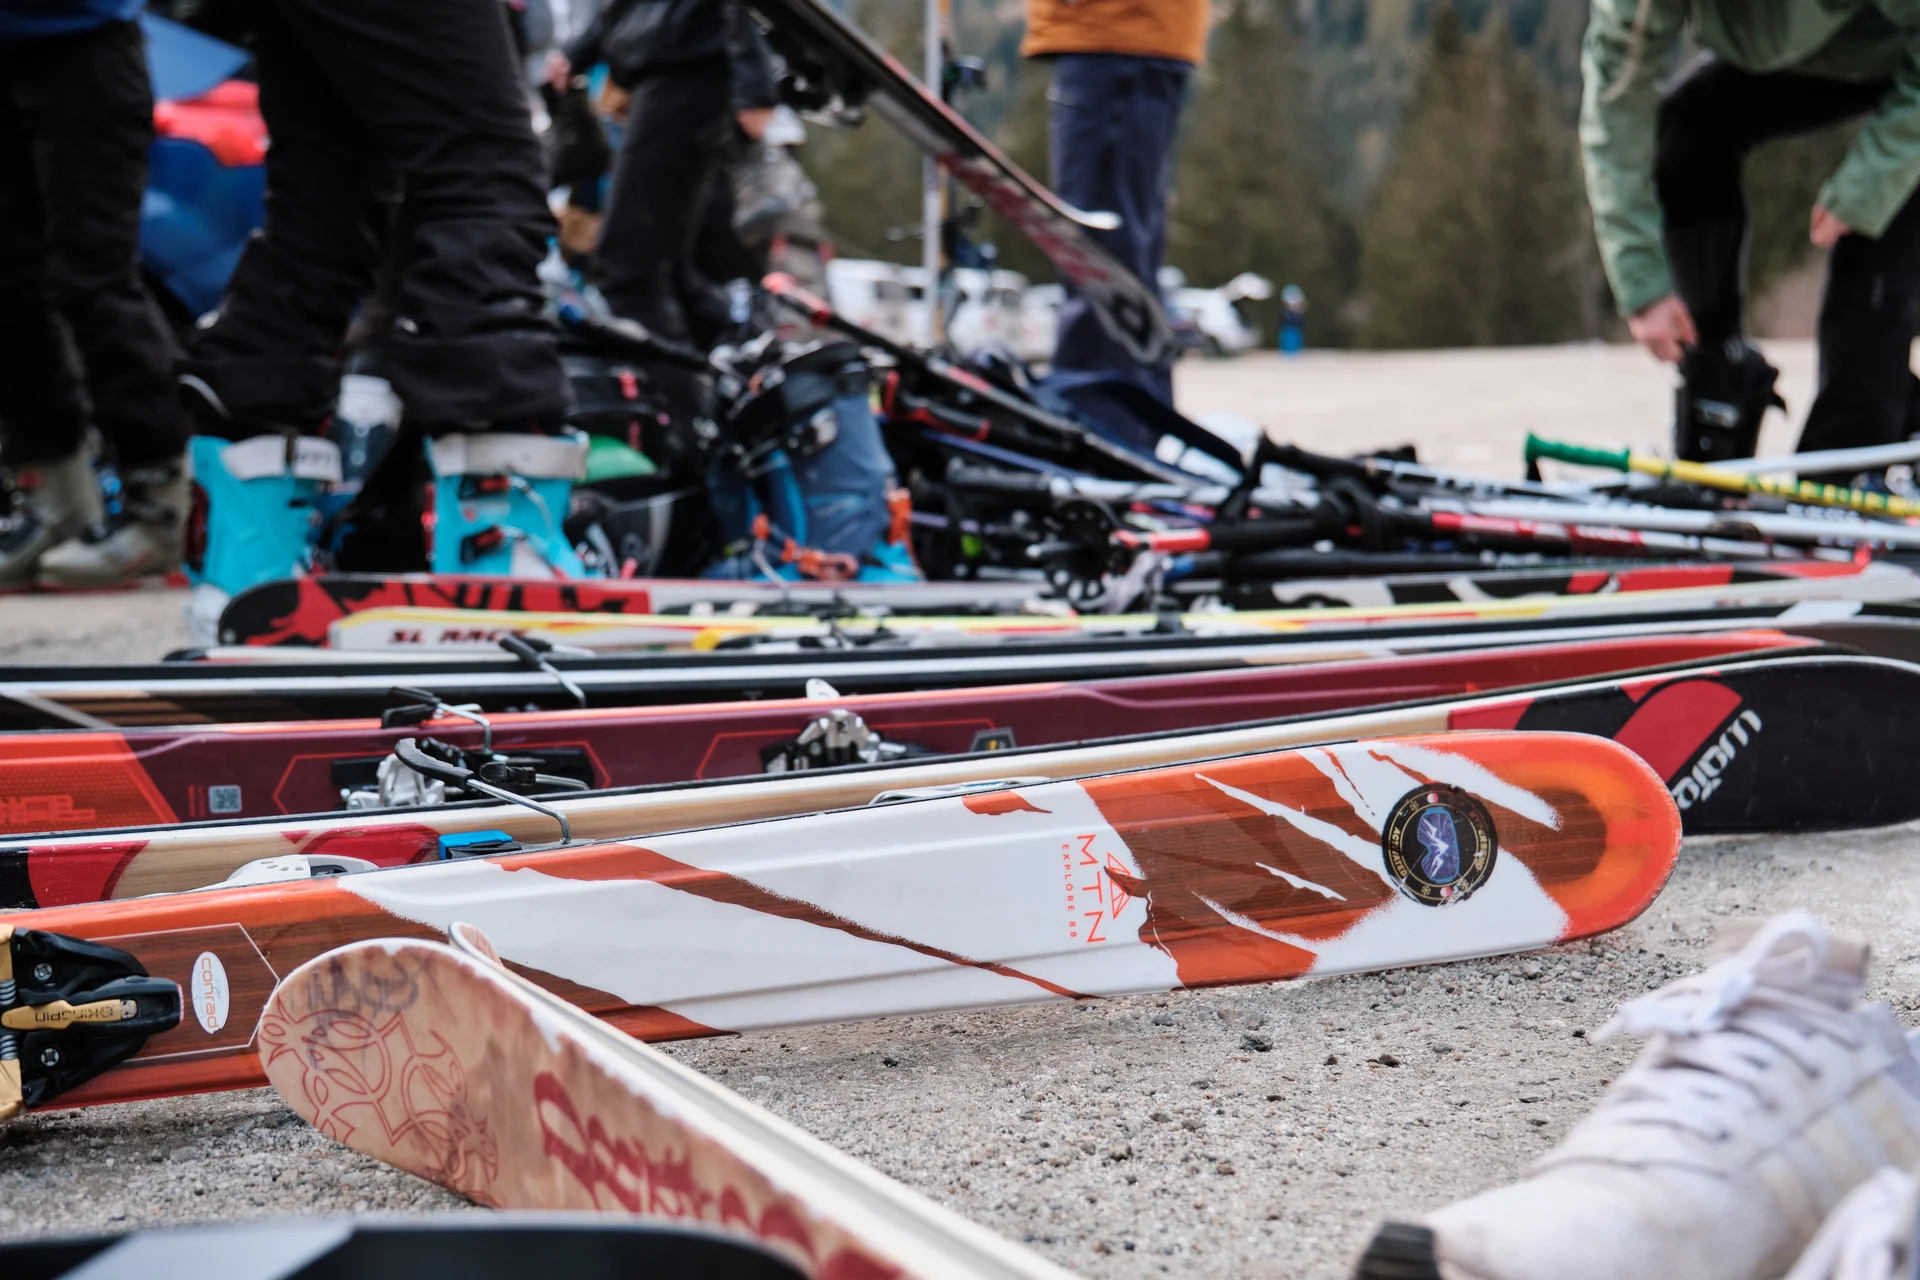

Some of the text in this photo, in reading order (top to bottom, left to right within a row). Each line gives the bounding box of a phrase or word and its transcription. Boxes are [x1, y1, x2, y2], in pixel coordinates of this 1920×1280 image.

[388, 629, 423, 644] SL
[1062, 844, 1077, 938] EXPLORE 88
[1077, 834, 1106, 942] MTN
[201, 957, 219, 1029] conrad
